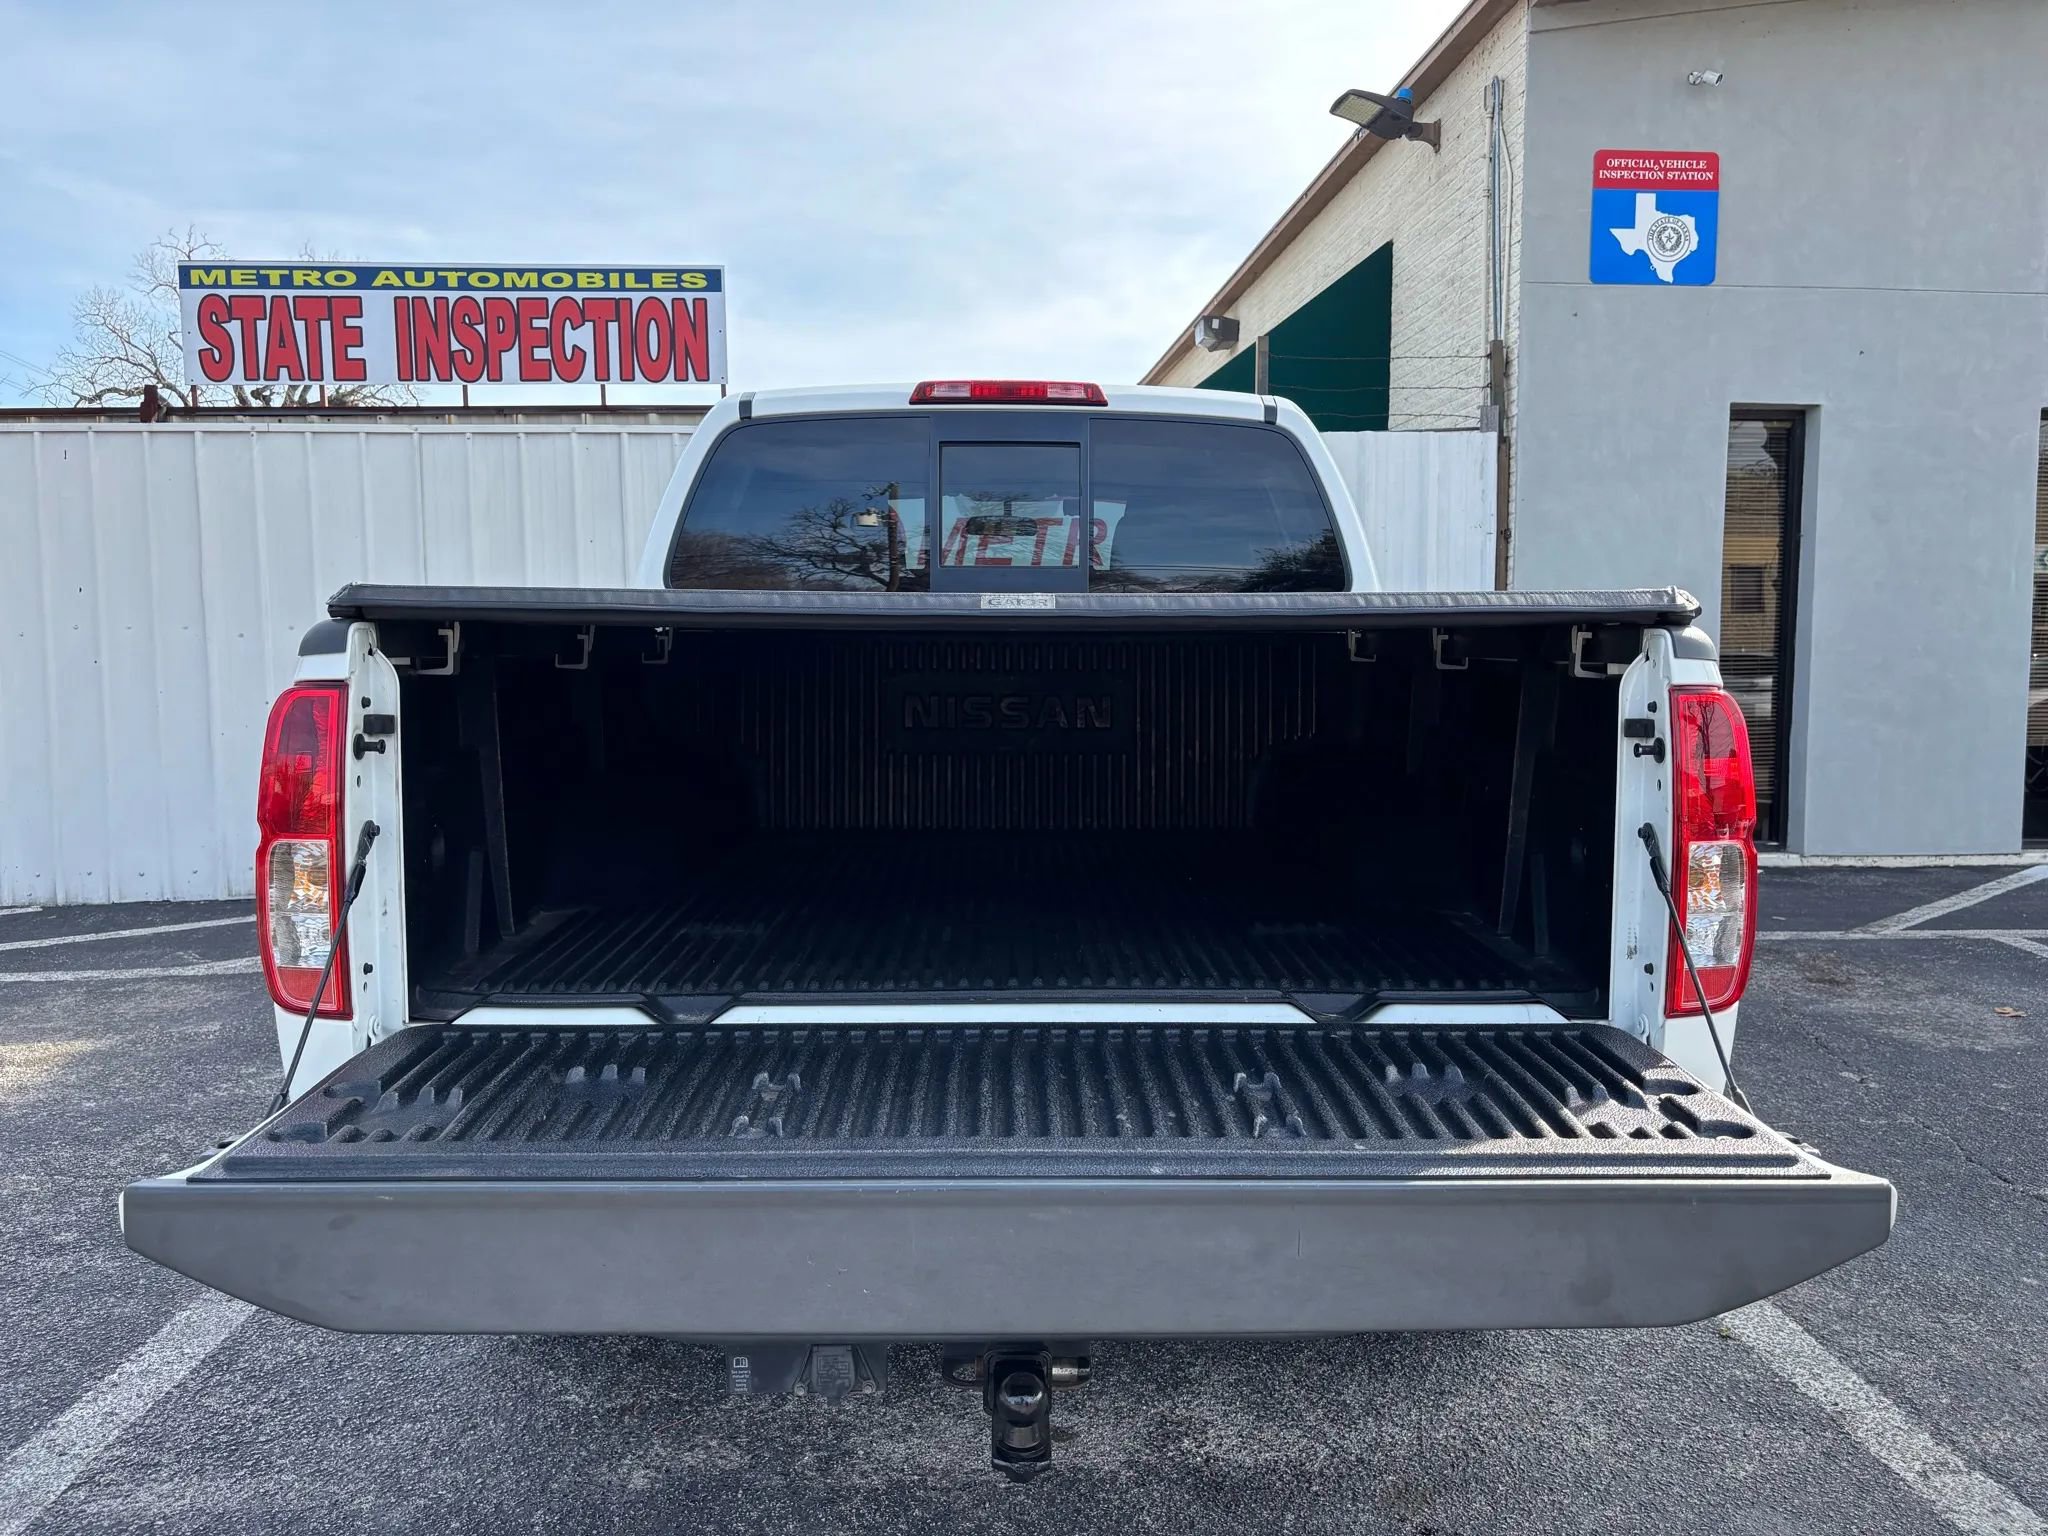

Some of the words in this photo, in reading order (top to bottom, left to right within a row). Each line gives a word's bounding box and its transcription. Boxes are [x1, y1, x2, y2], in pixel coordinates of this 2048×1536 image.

[1606, 158, 1655, 168] OFFICIAL
[1659, 159, 1707, 169] VEHICLE
[1599, 169, 1664, 180] INSPECTION
[1666, 171, 1714, 181] STATION
[190, 269, 357, 287] METRO
[371, 270, 708, 289] AUTOMOBILES
[197, 293, 367, 382] STATE
[394, 295, 710, 383] INSPECTION
[904, 695, 1112, 729] NISSAN
